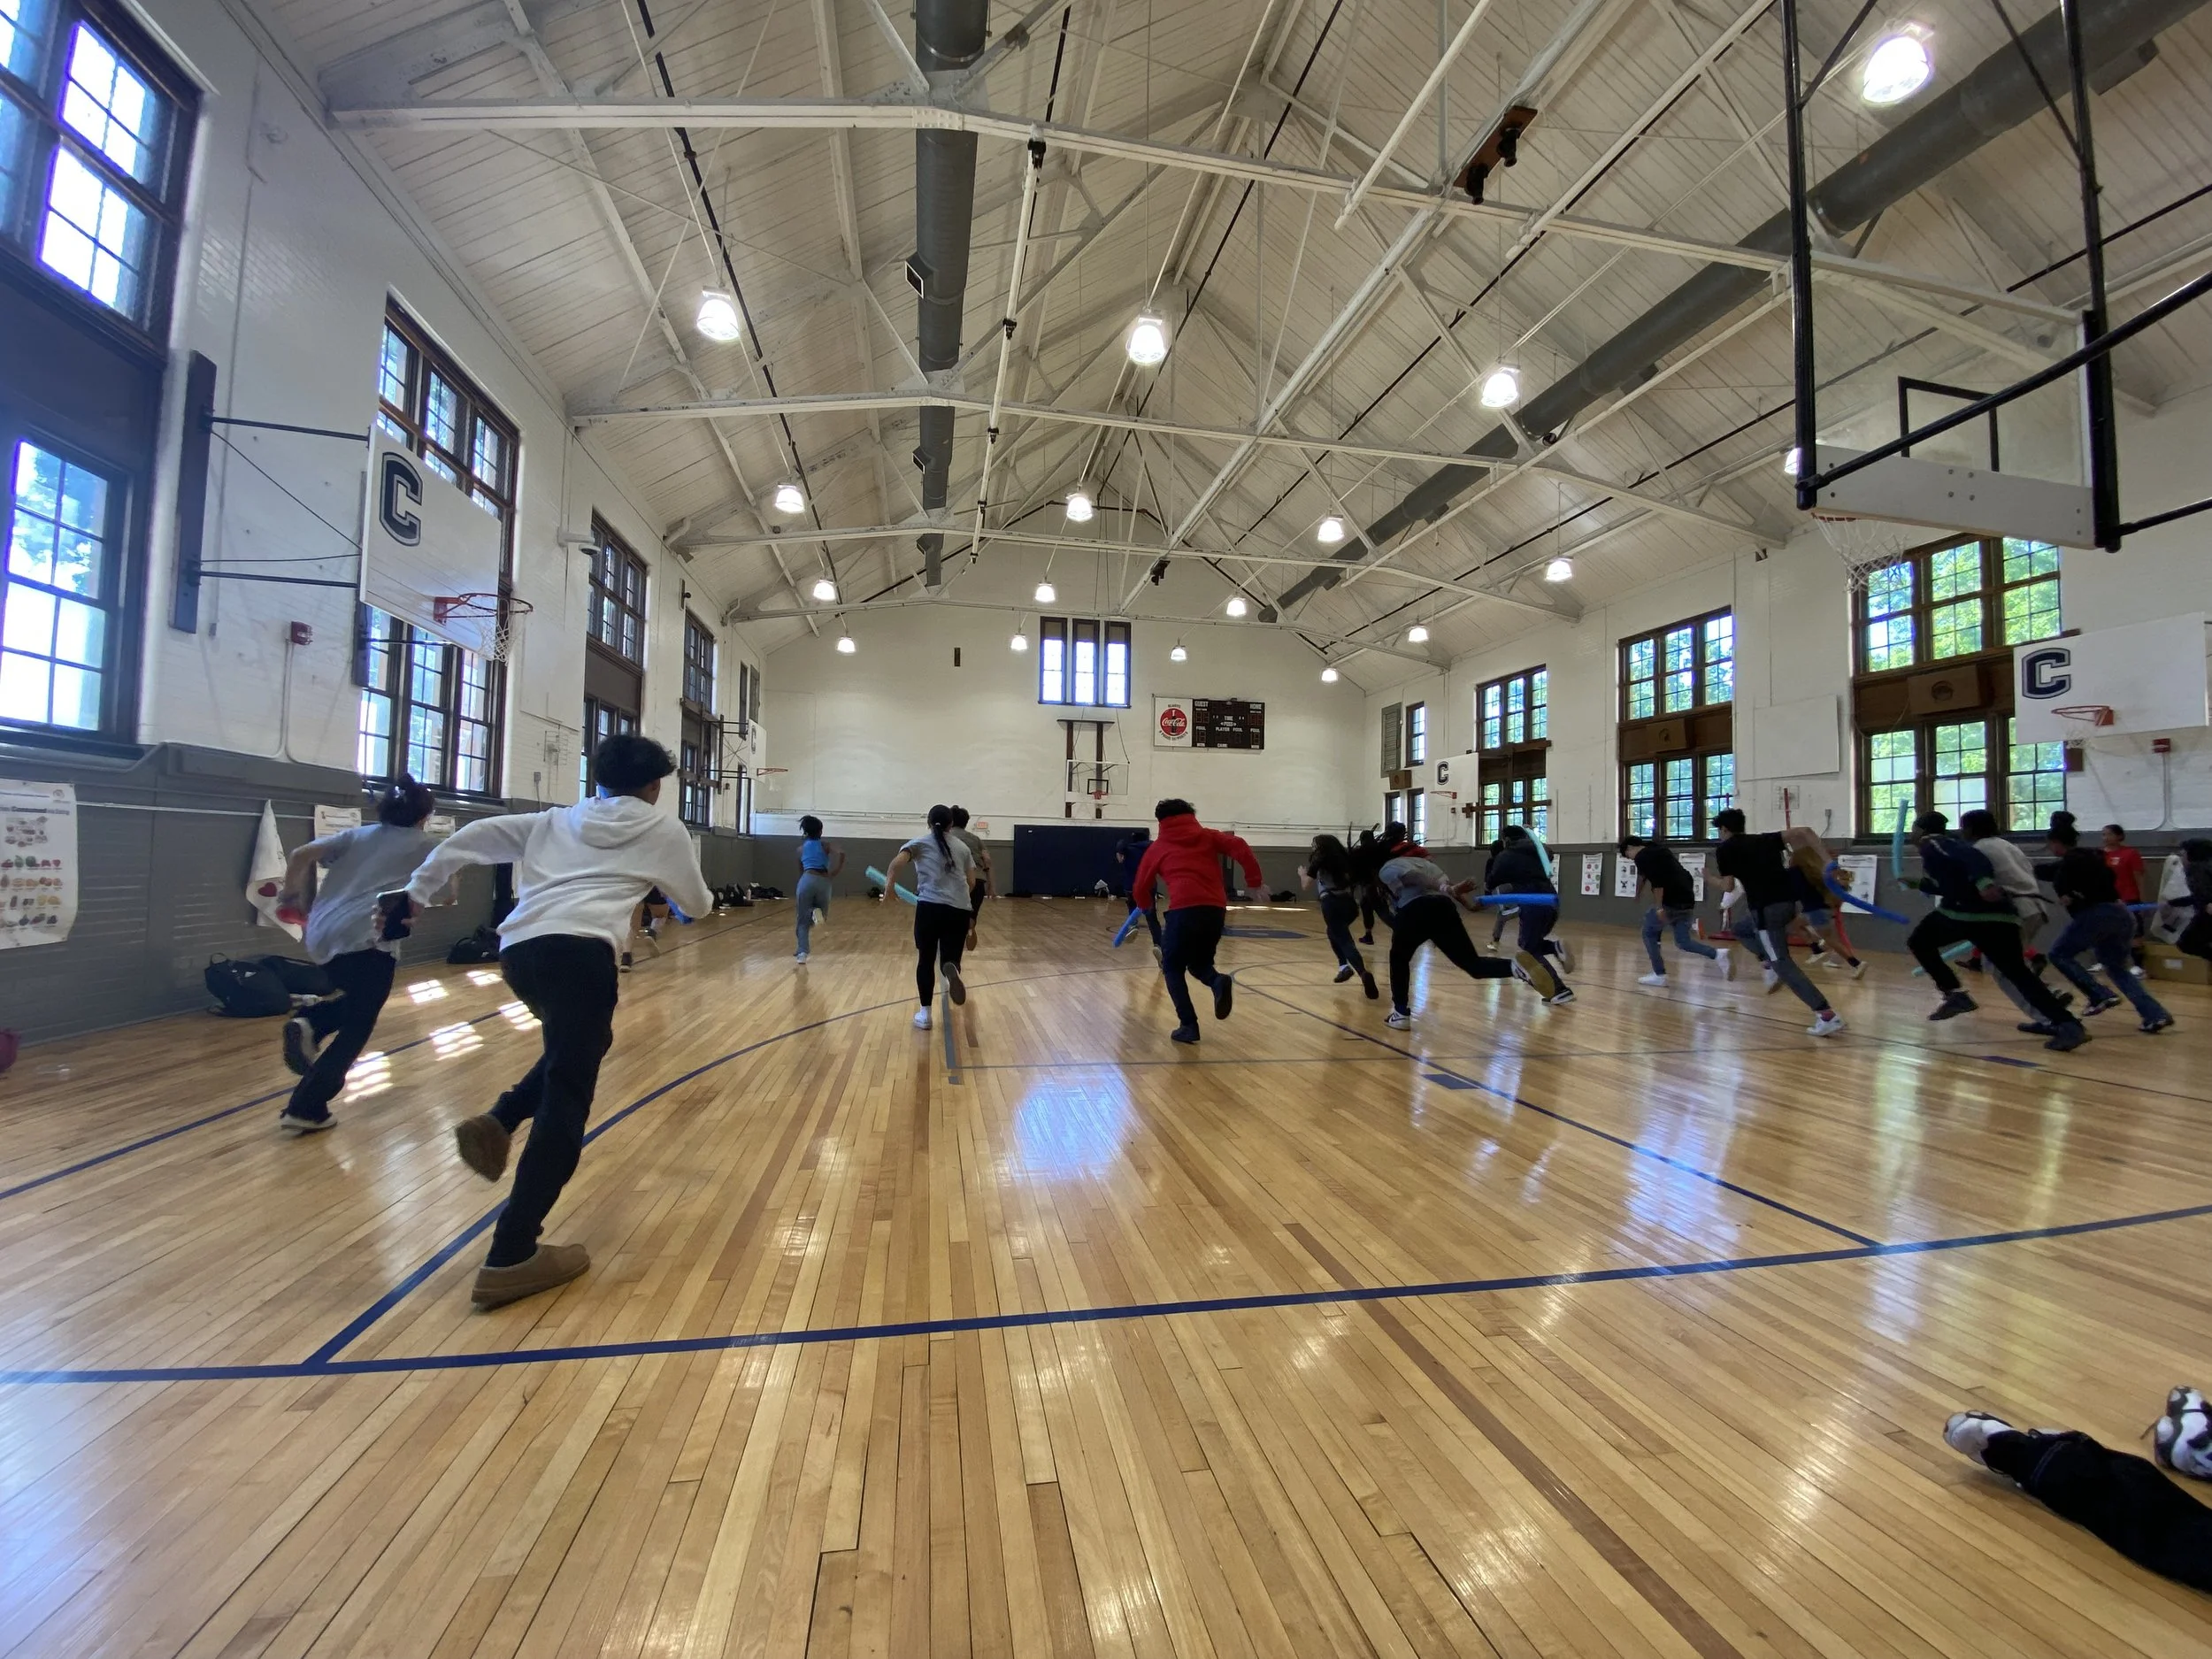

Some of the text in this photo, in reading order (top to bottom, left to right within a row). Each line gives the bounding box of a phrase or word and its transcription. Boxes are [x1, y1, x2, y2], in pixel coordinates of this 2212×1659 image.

[380, 451, 423, 547] C
[2022, 648, 2071, 699] C
[1437, 761, 1449, 785] C
